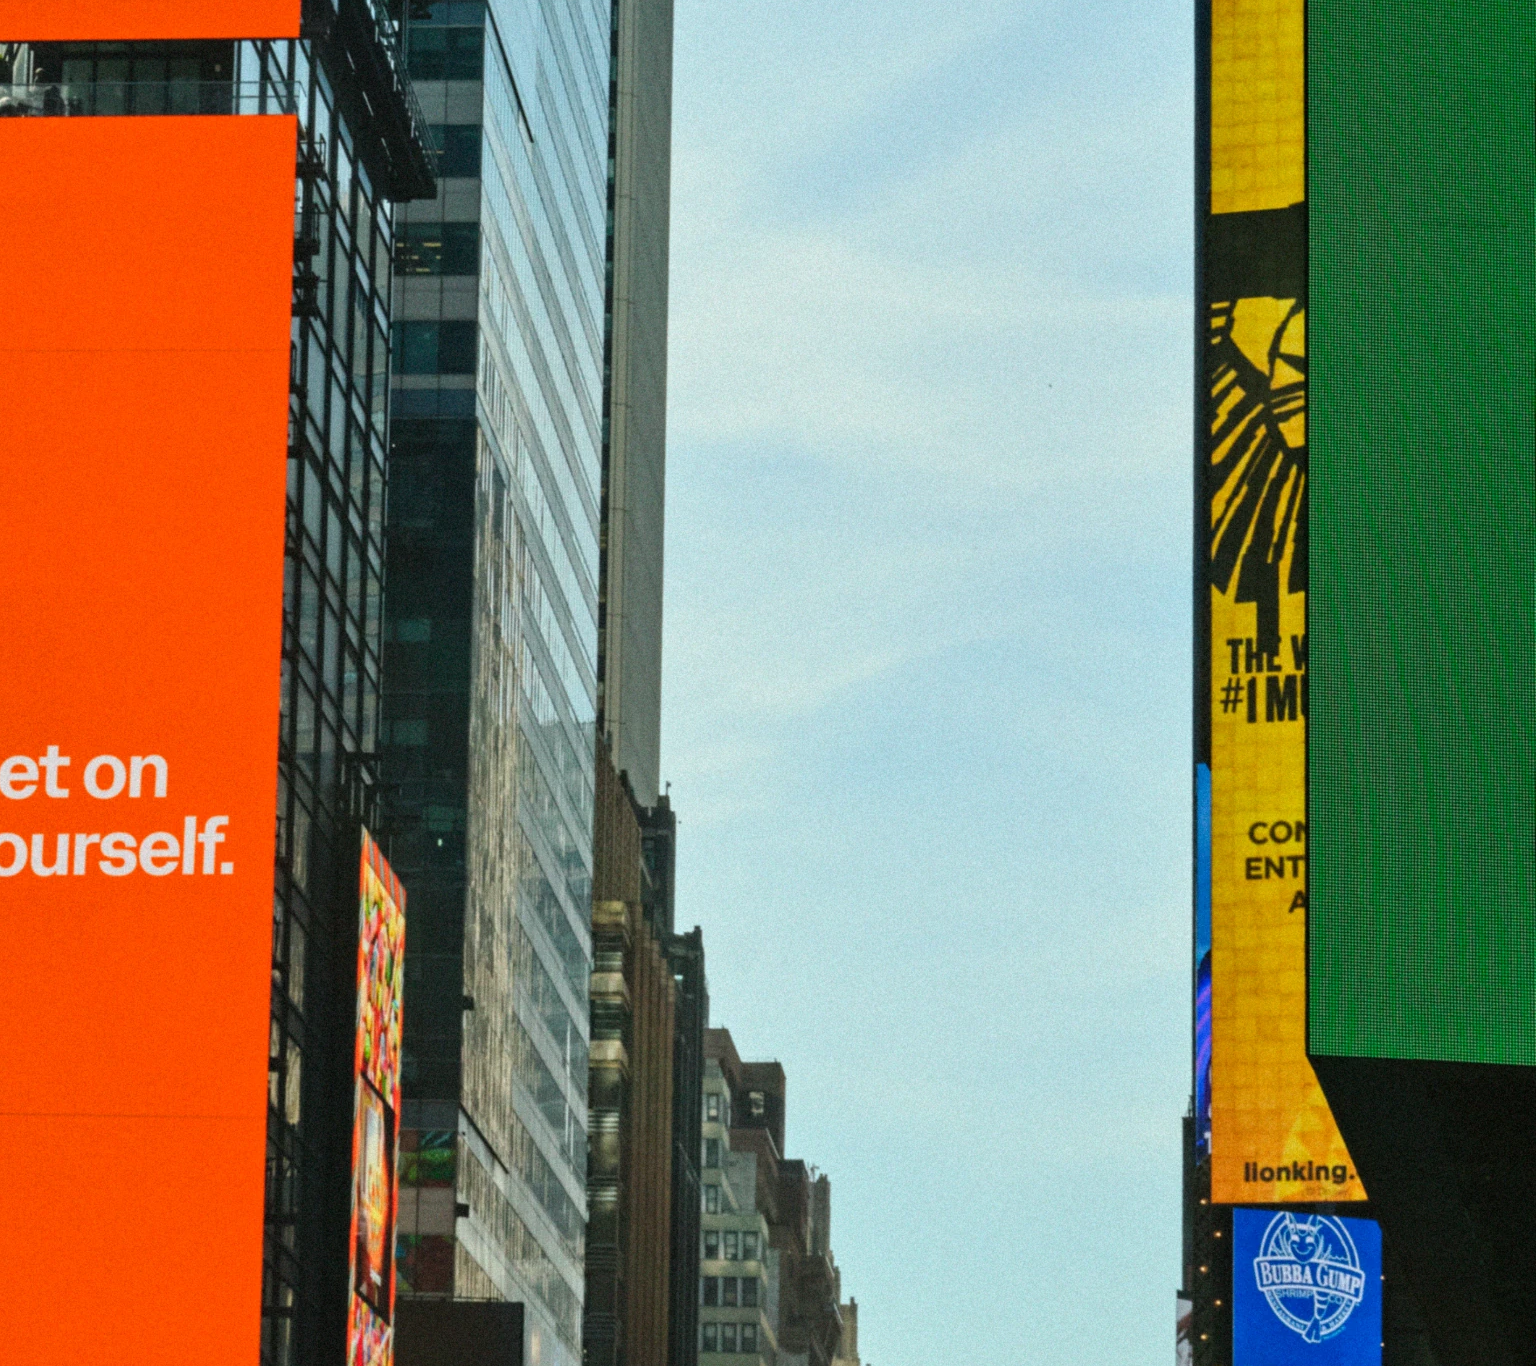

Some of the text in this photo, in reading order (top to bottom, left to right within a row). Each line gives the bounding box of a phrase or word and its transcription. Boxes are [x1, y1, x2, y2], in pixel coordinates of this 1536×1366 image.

[1227, 637, 1283, 674] THE
[83, 754, 168, 799] on
[1260, 1261, 1361, 1296] BUBBA GUMP
